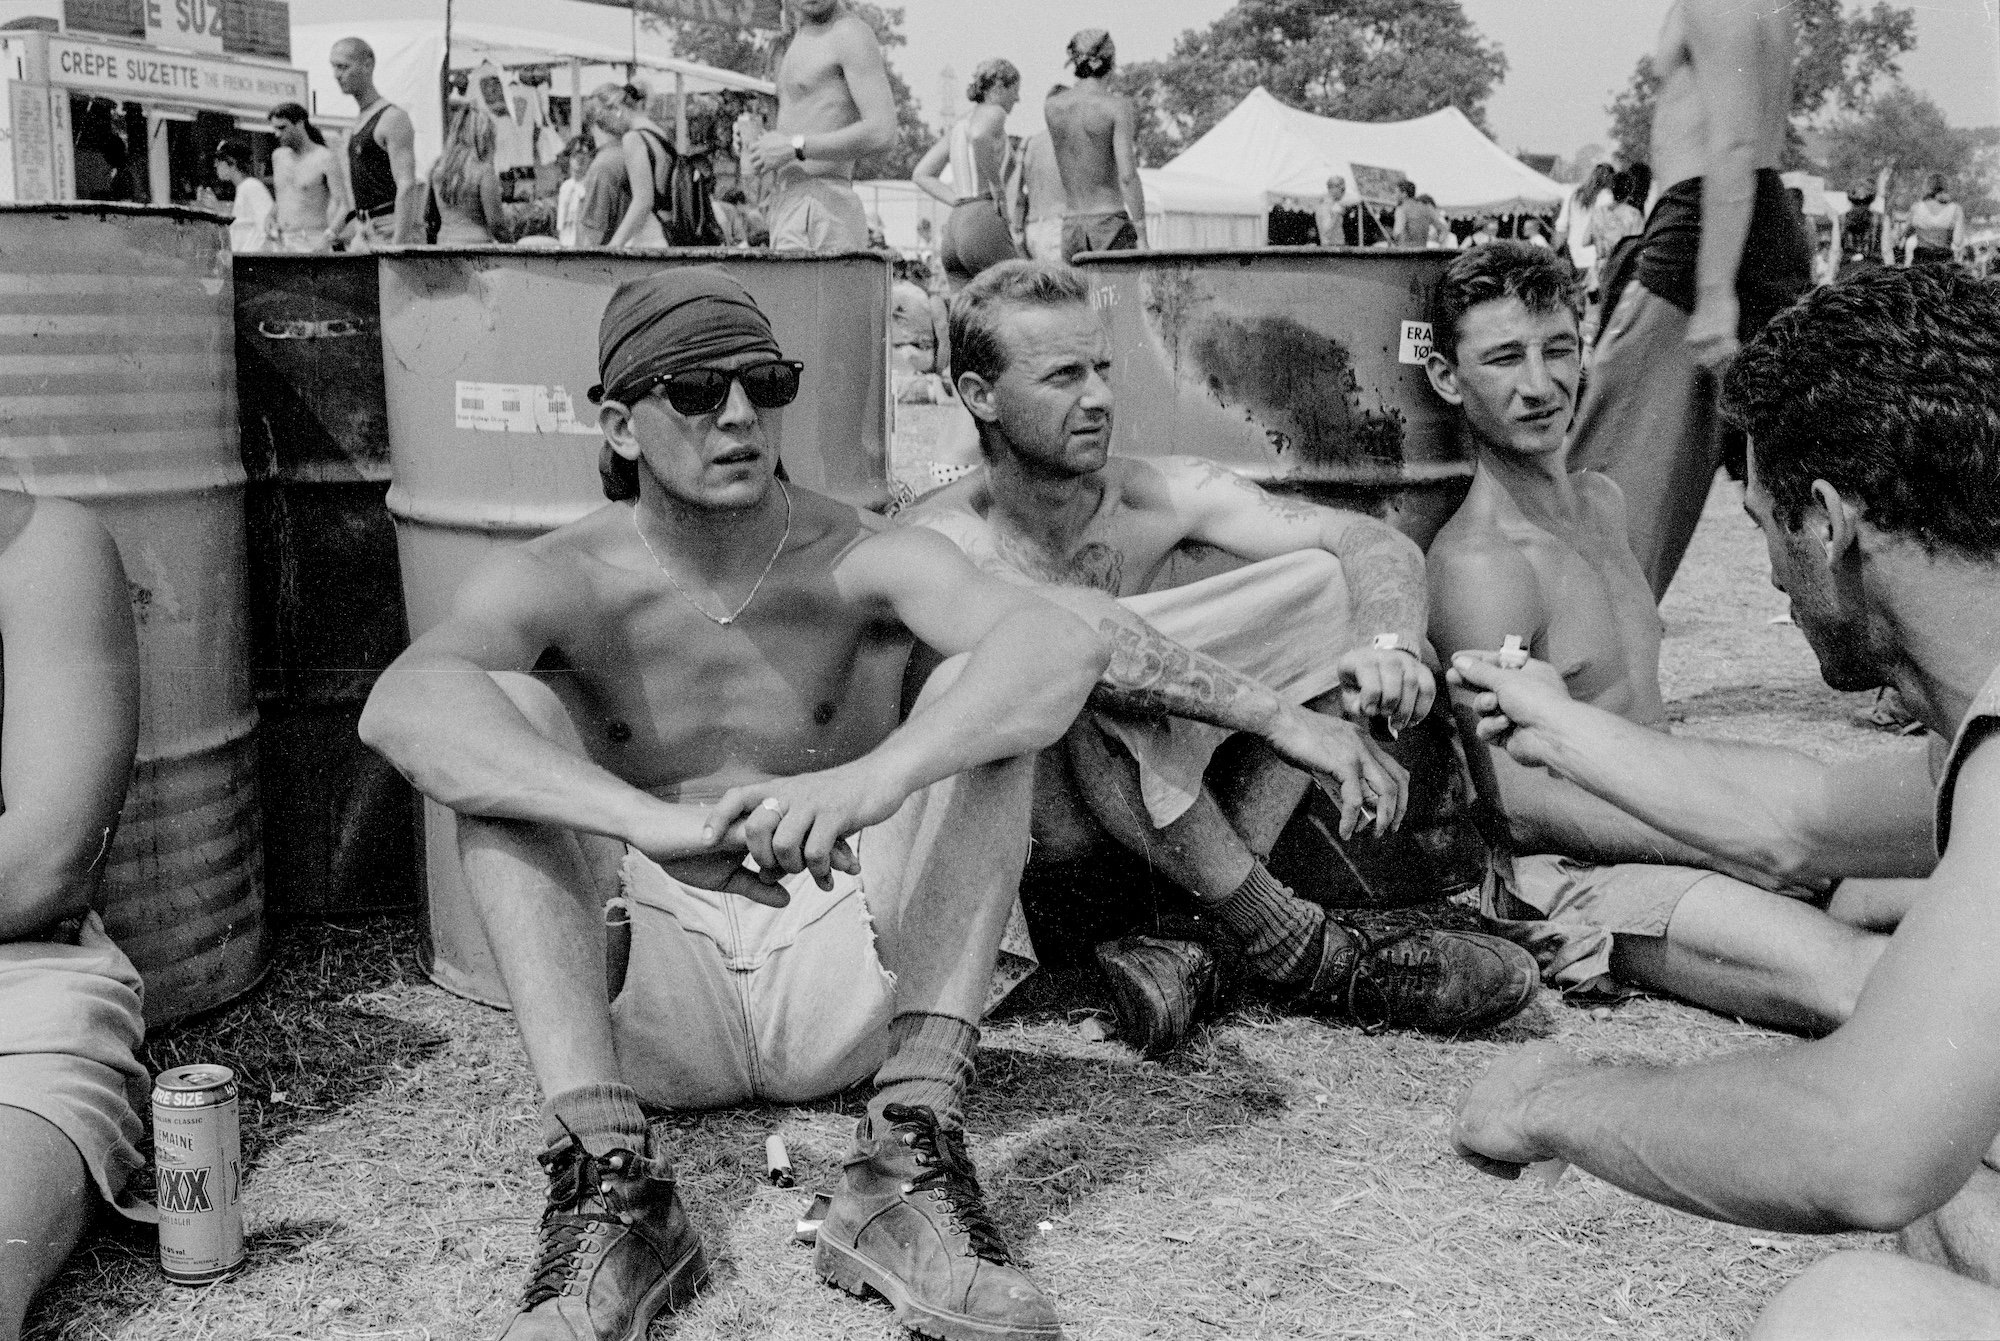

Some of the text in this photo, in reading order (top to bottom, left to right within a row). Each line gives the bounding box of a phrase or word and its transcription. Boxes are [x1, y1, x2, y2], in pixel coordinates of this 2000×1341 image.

[126, 58, 199, 89] SUZETTE
[1407, 326, 1432, 341] ERA
[173, 1091, 204, 1106] SIZE
[174, 1117, 203, 1125] CLASSIC
